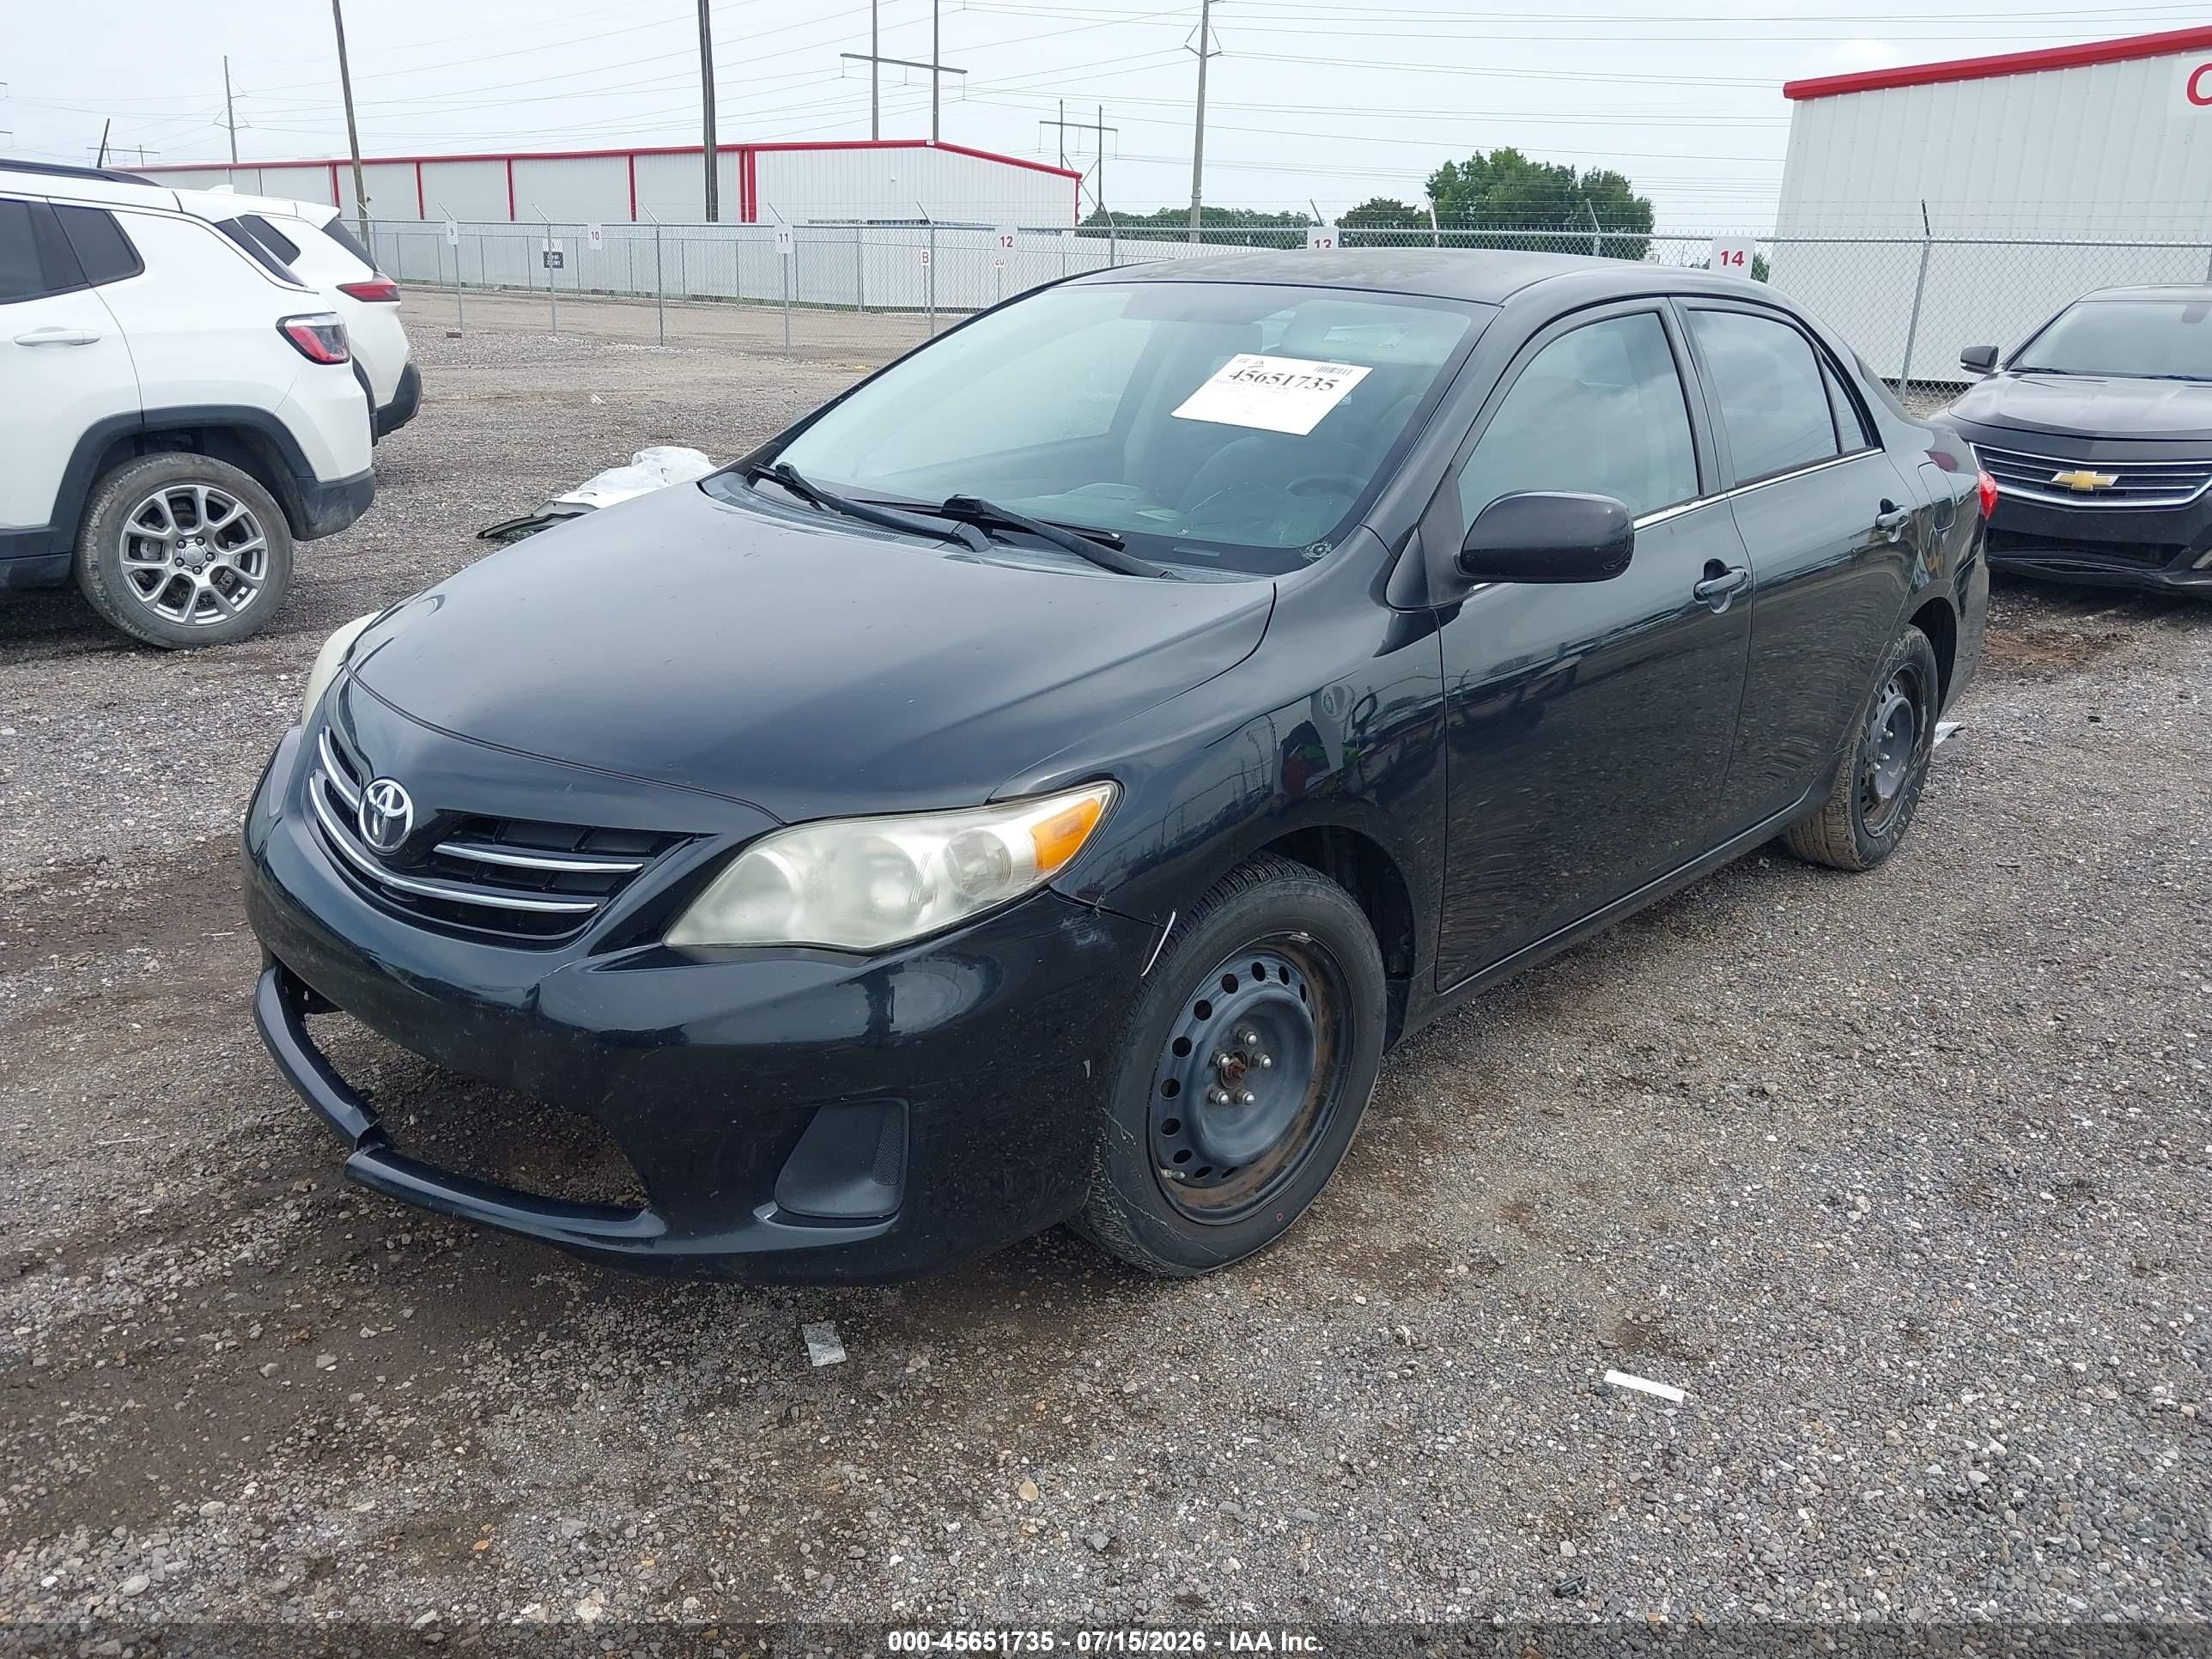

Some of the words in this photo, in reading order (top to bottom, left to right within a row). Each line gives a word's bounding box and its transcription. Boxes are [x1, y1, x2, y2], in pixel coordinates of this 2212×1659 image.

[591, 231, 600, 241] 10
[779, 233, 788, 243] 11
[1000, 235, 1014, 248] 12
[1720, 250, 1745, 267] 14
[1228, 368, 1340, 392] 45651735
